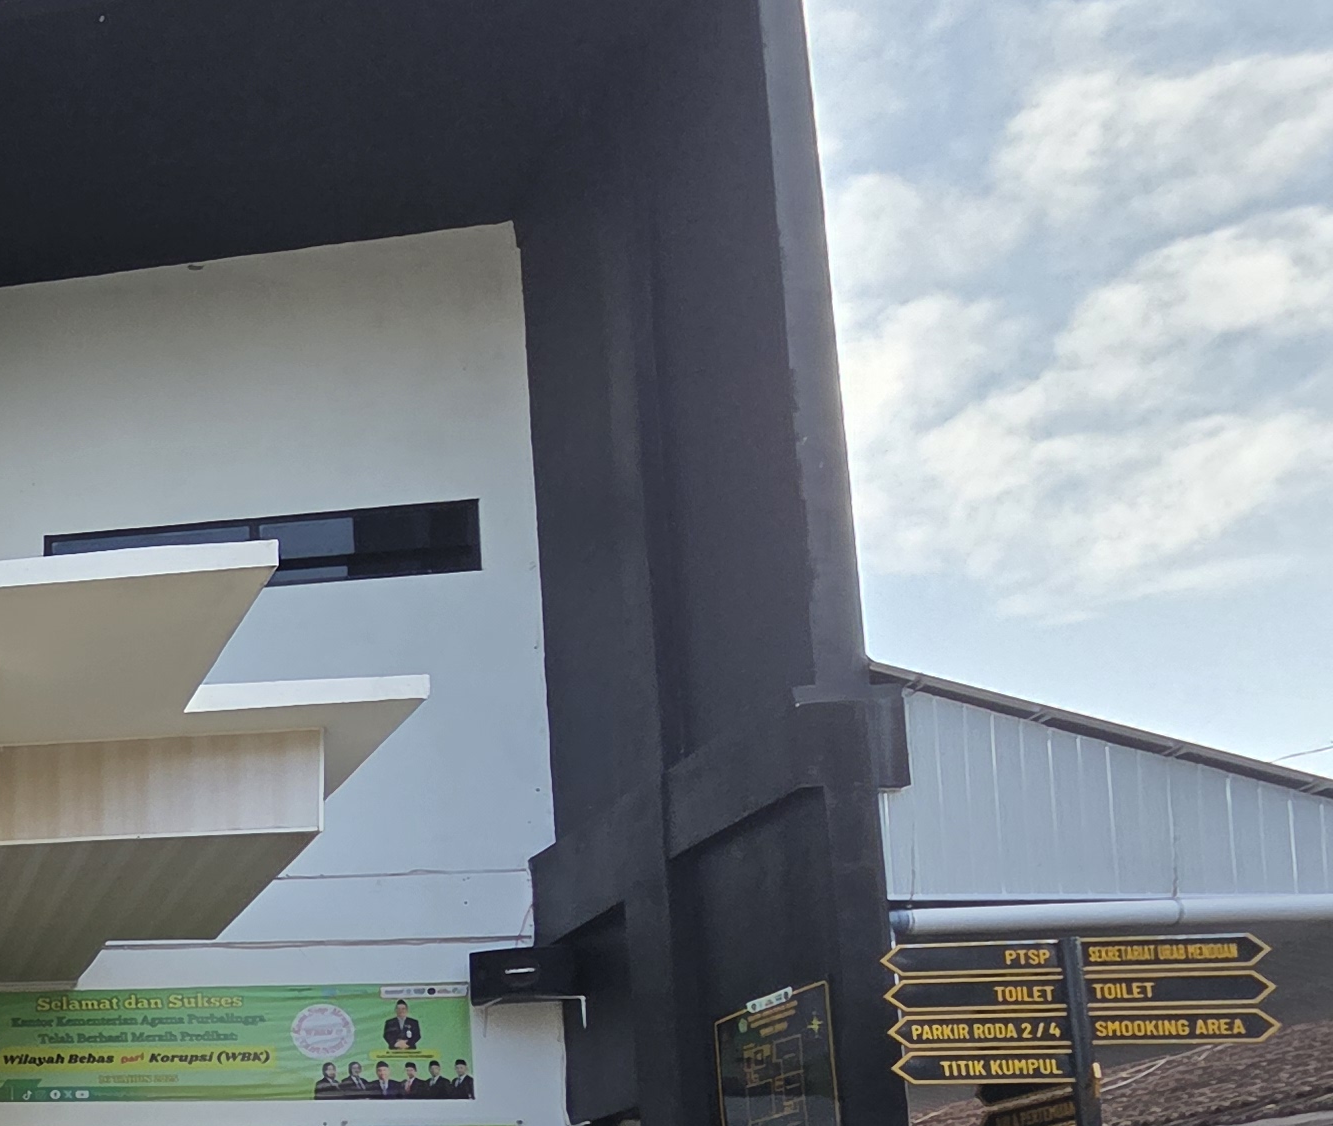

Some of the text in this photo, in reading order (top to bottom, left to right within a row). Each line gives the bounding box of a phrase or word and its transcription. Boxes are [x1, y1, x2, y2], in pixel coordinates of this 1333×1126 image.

[1004, 949, 1050, 965] PTSP
[1088, 945, 1155, 962] SEKRETARIAT
[993, 986, 1055, 1002] TOILET
[1092, 982, 1155, 999] TOILET
[36, 993, 243, 1011] Selamat dan Sukses
[911, 1022, 1062, 1040] PARKIR RODA 2 / 4
[1095, 1019, 1247, 1037] SMOOKING AREA
[3, 1053, 65, 1067] Wilayah
[68, 1053, 114, 1064] Bebas
[148, 1052, 214, 1065] Korupsi
[216, 1050, 270, 1064] (WBK)
[939, 1058, 1064, 1077] TITIK KUMPUL
